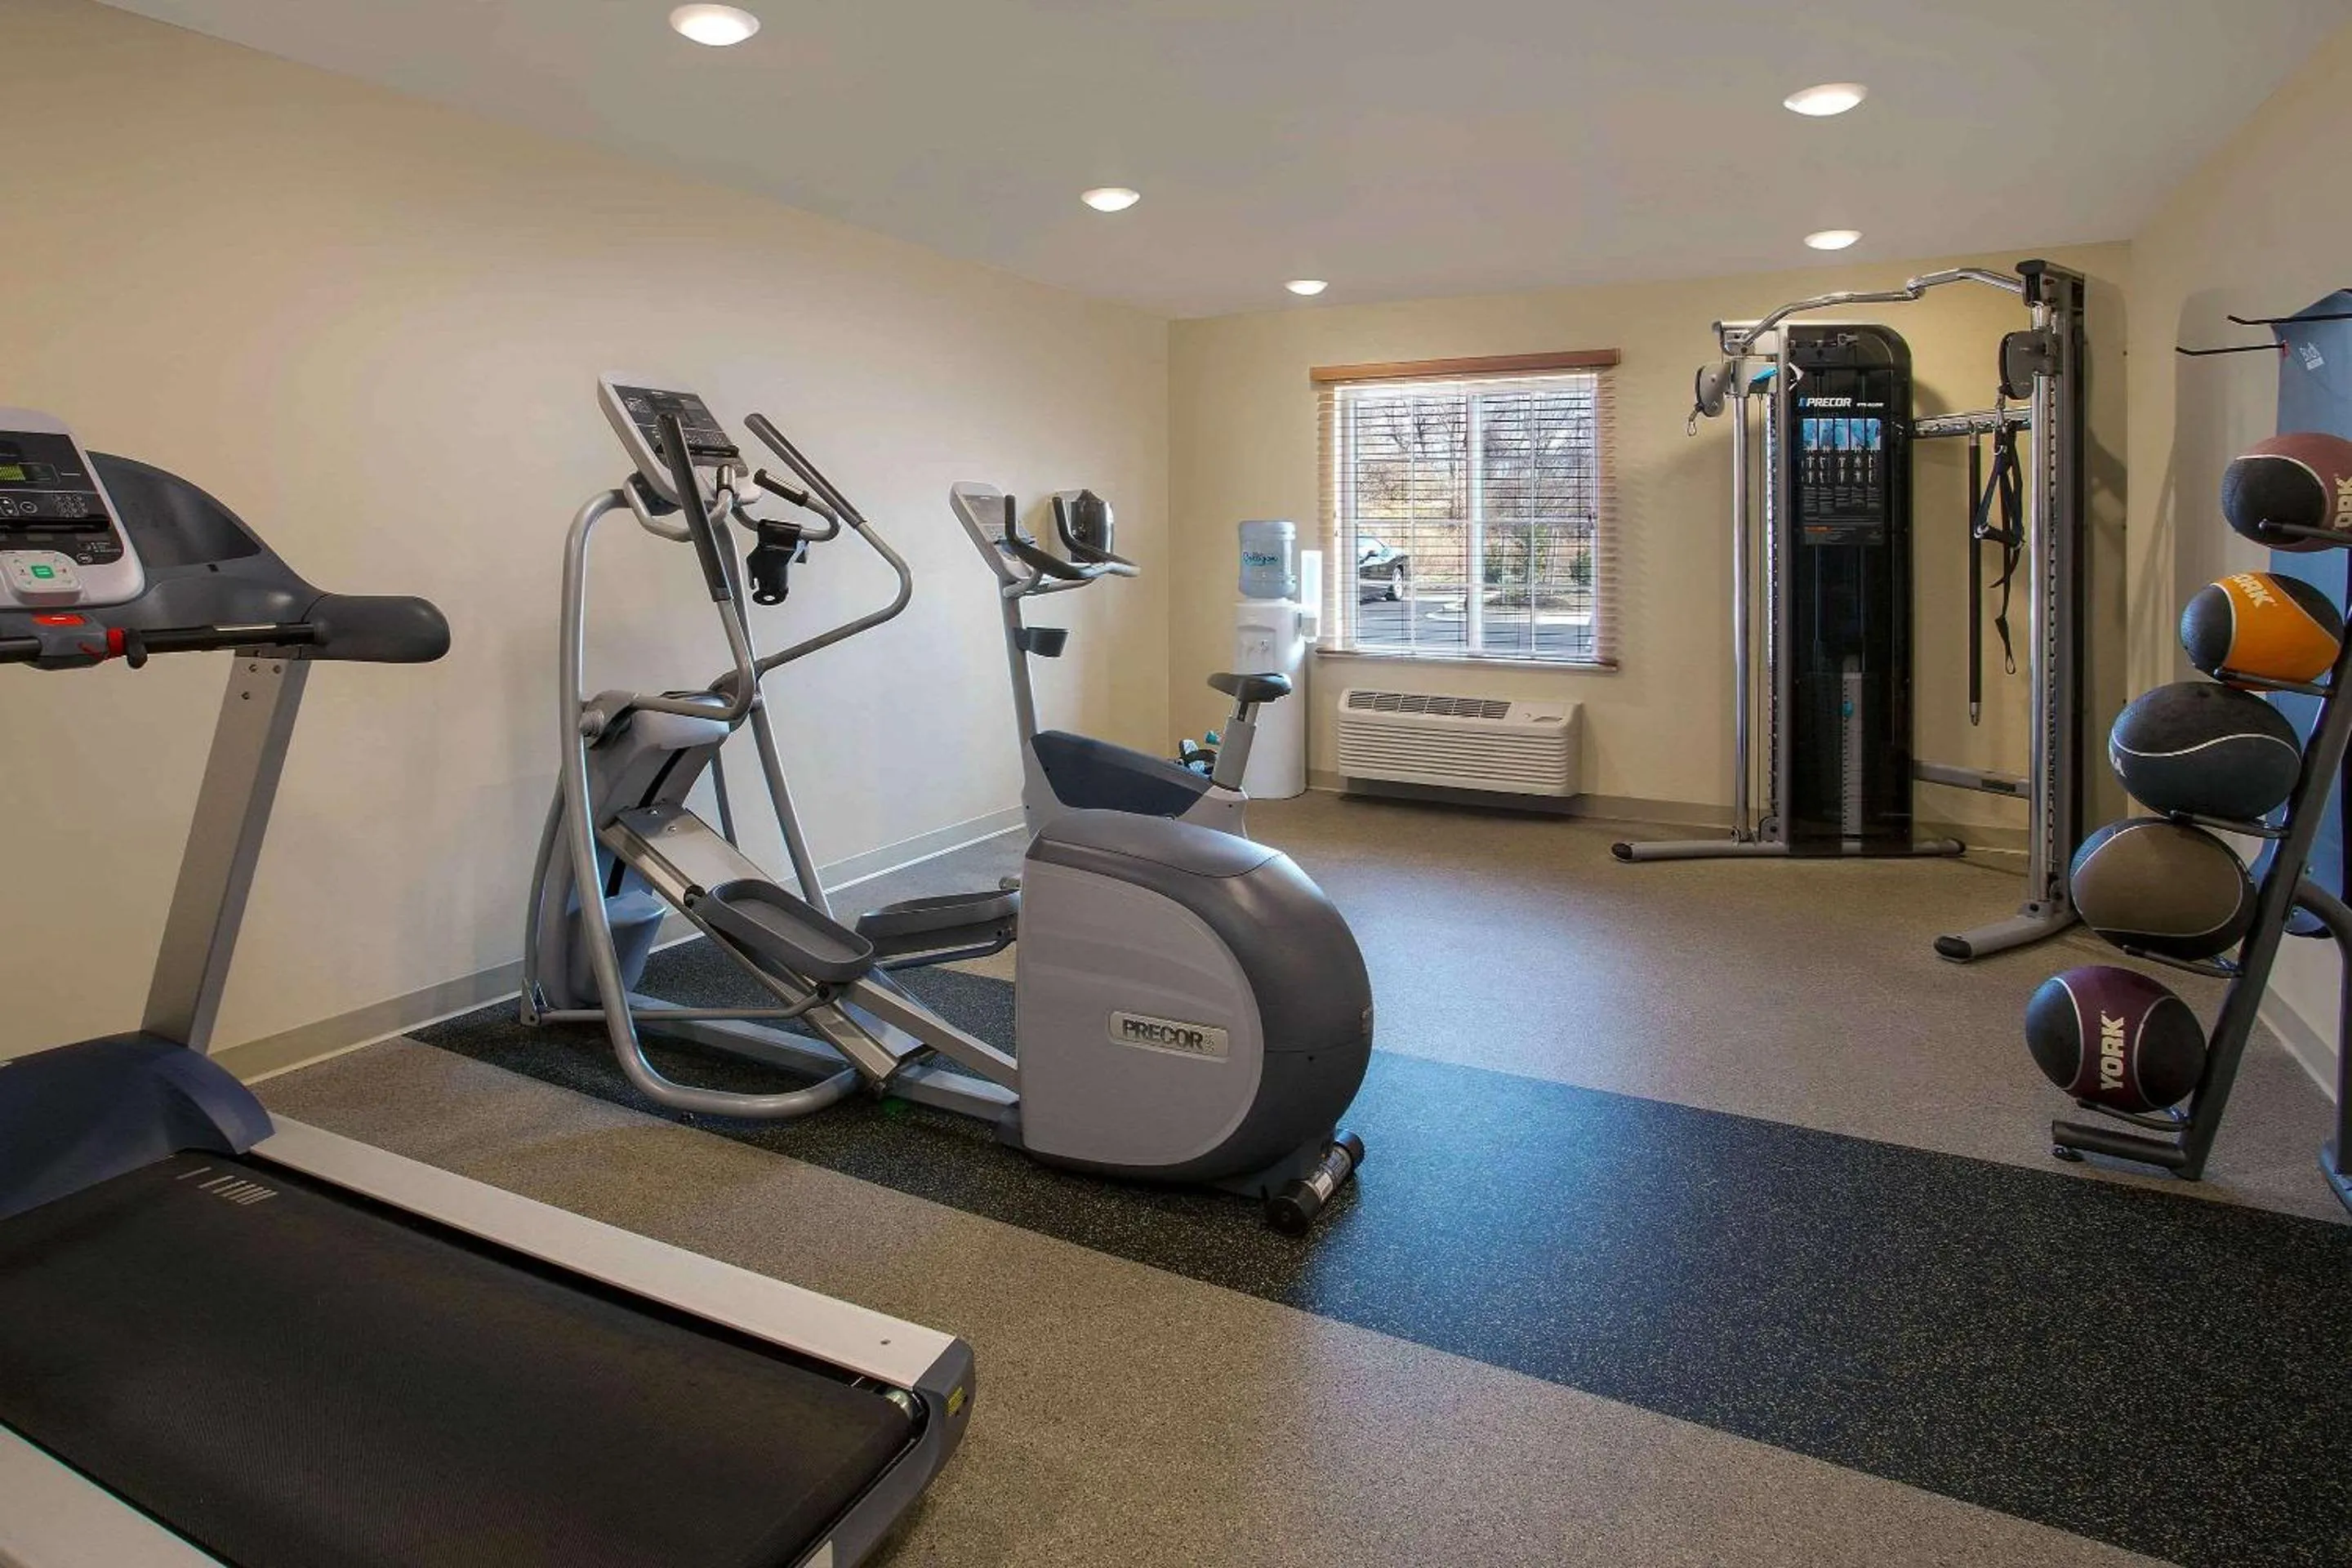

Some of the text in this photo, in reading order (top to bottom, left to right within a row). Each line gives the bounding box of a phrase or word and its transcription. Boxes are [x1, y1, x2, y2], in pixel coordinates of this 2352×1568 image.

[1806, 397, 1852, 408] PRECOR
[2334, 477, 2352, 531] ORK
[1122, 1018, 1205, 1051] PRECOR
[2100, 1013, 2124, 1090] YORK
